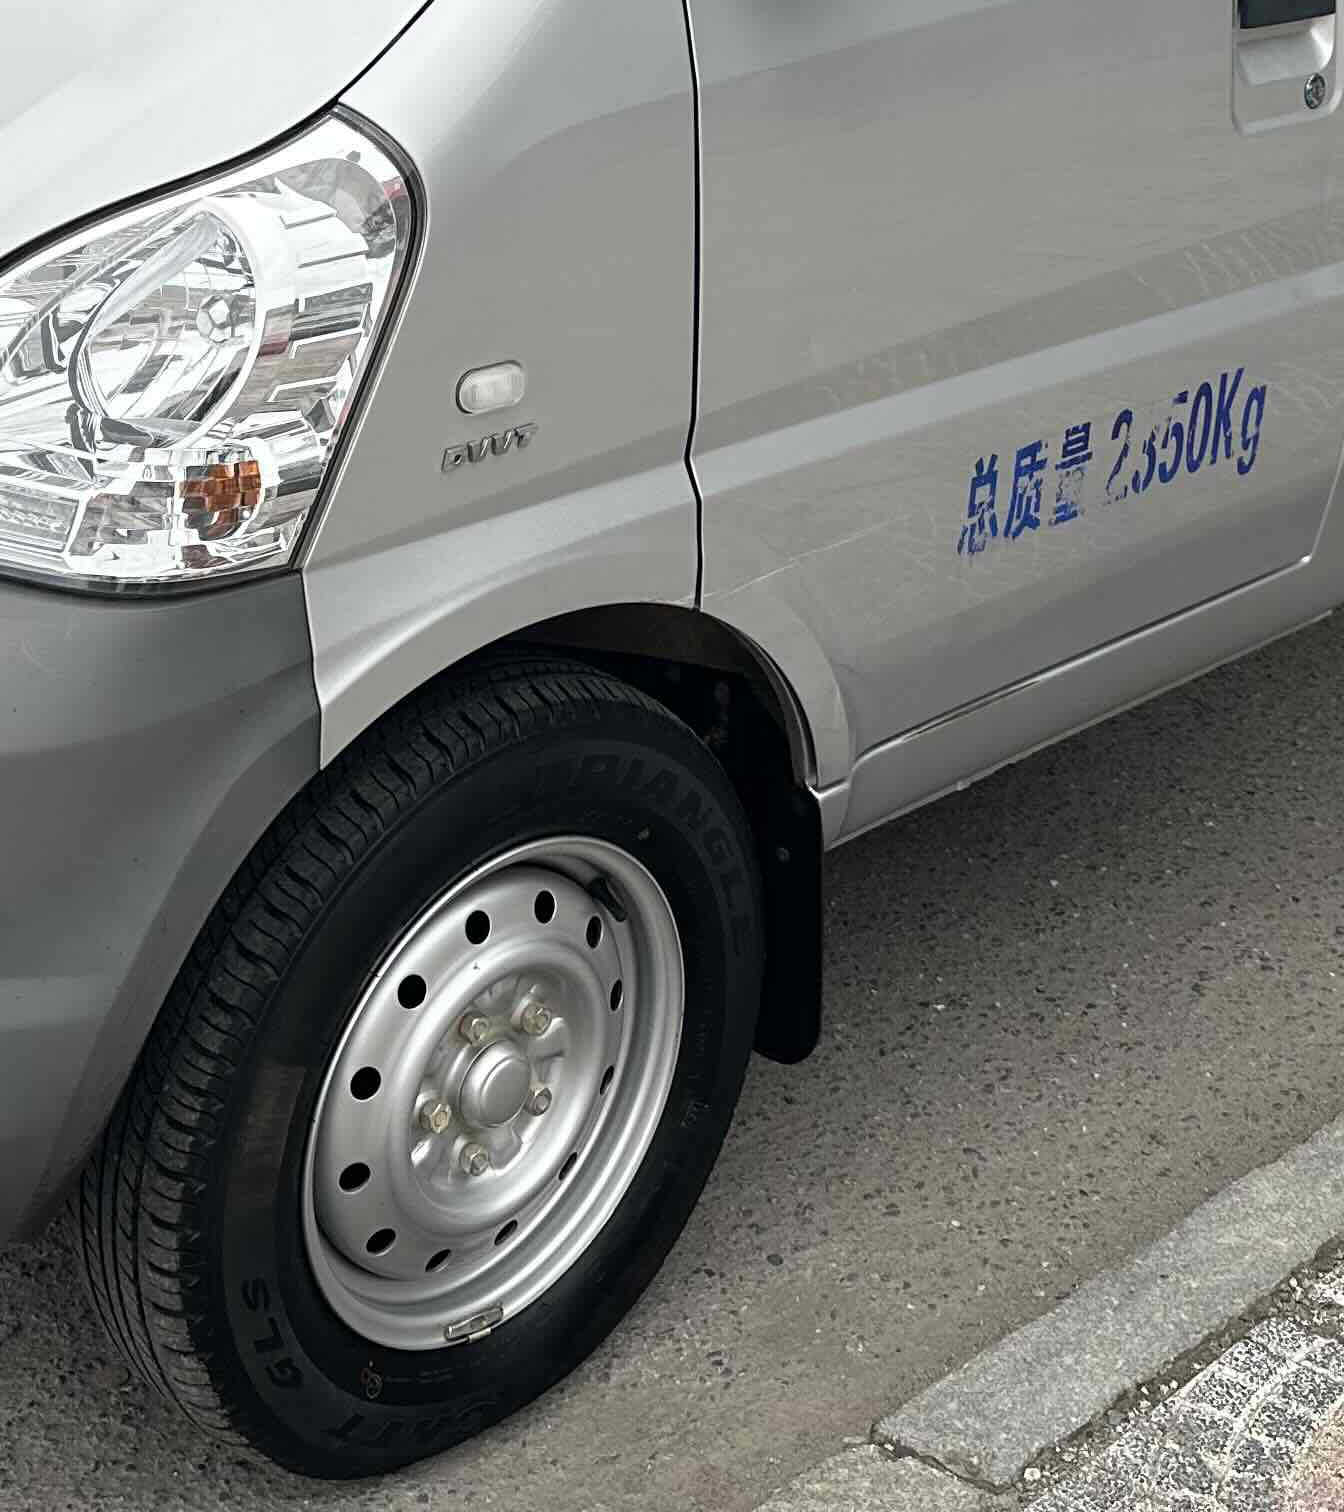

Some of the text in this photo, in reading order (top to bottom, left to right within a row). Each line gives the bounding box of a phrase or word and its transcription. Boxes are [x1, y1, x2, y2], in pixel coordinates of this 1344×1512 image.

[441, 422, 538, 473] DVVT
[957, 367, 1267, 556] 总质量 2350Kg
